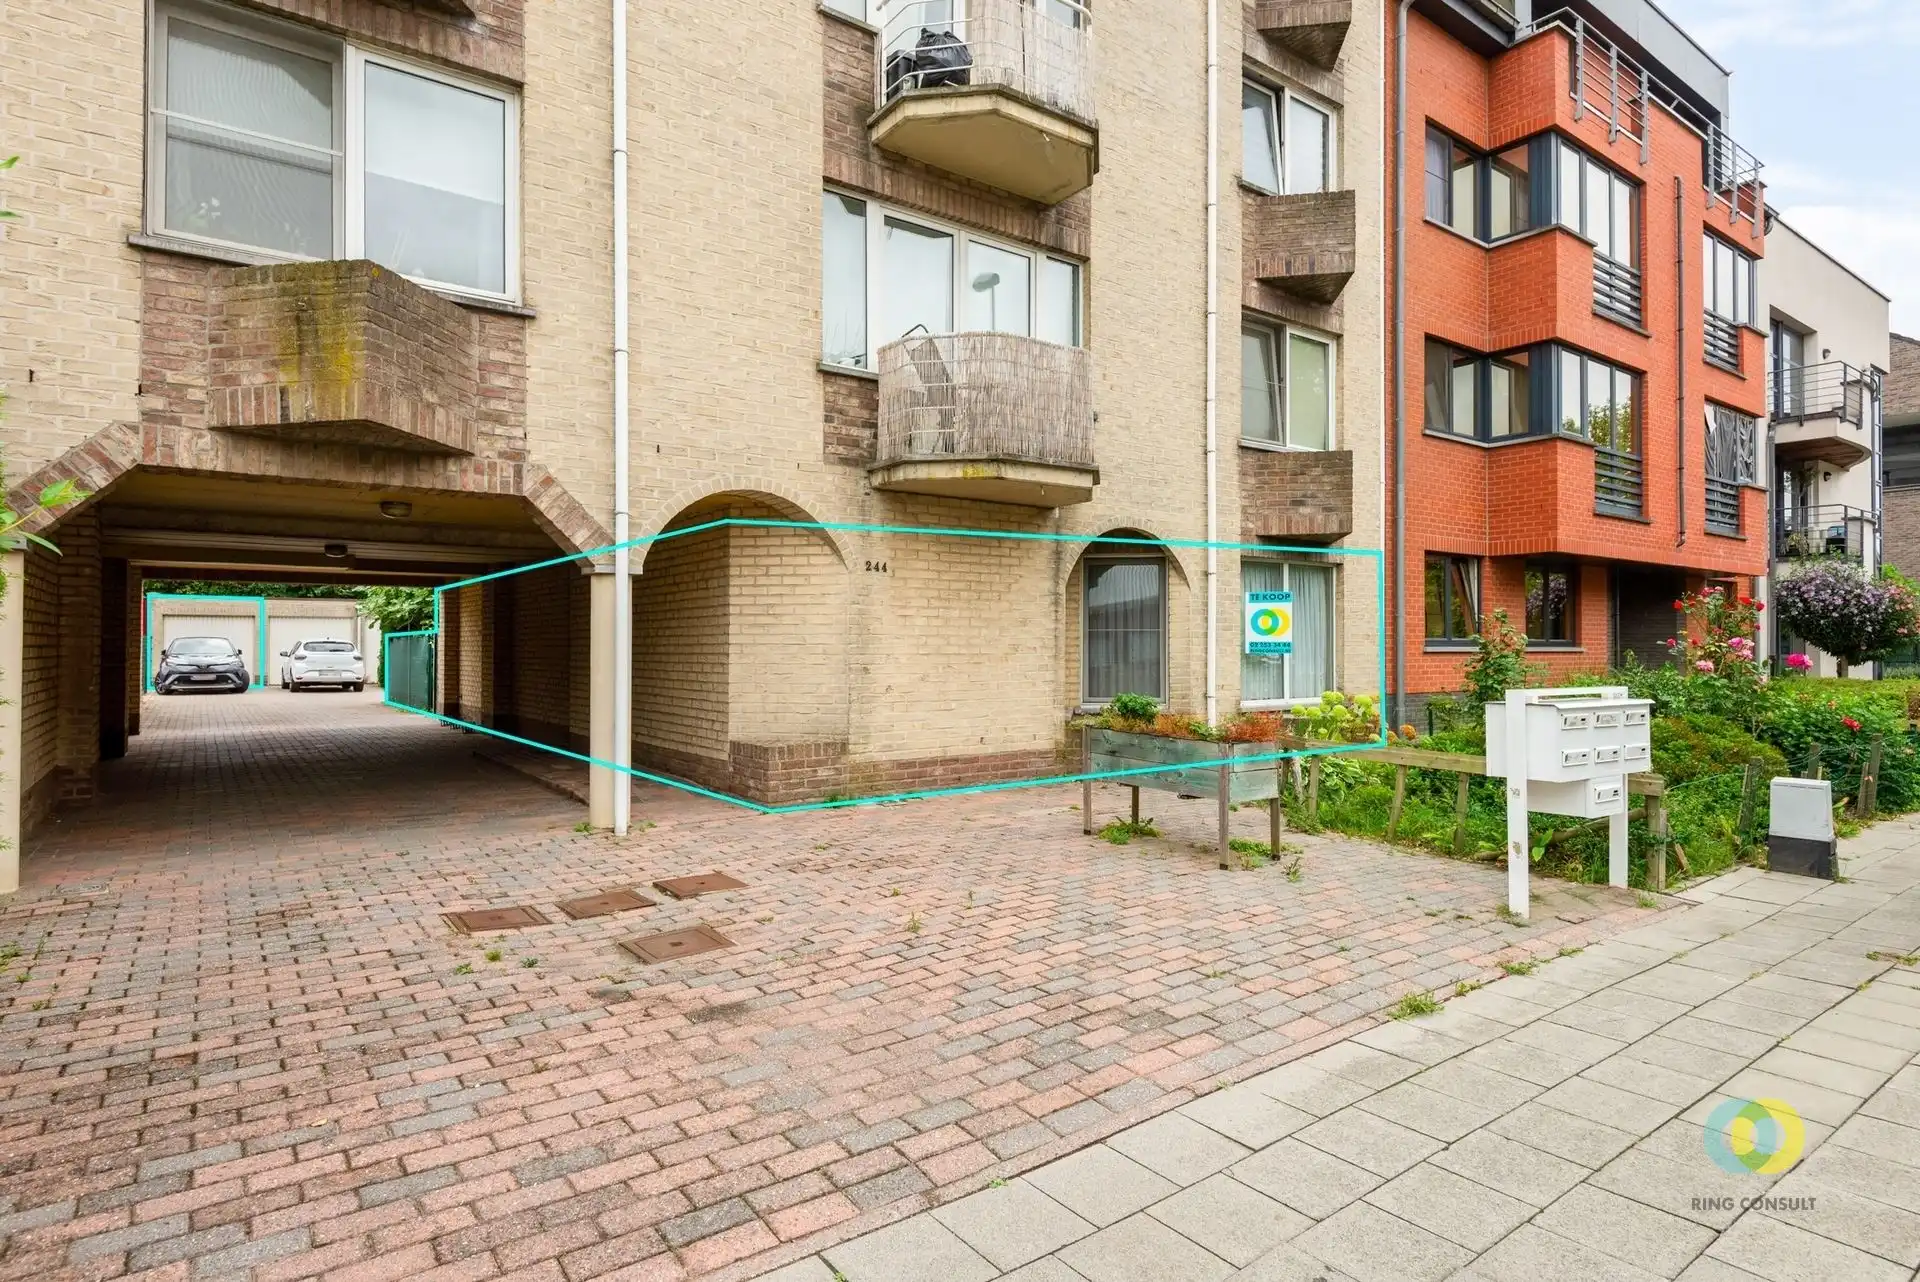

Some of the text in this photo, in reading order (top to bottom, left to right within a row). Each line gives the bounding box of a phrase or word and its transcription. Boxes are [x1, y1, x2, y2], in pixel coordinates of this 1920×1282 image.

[865, 560, 888, 573] 244
[1249, 593, 1291, 601] TE KOOP
